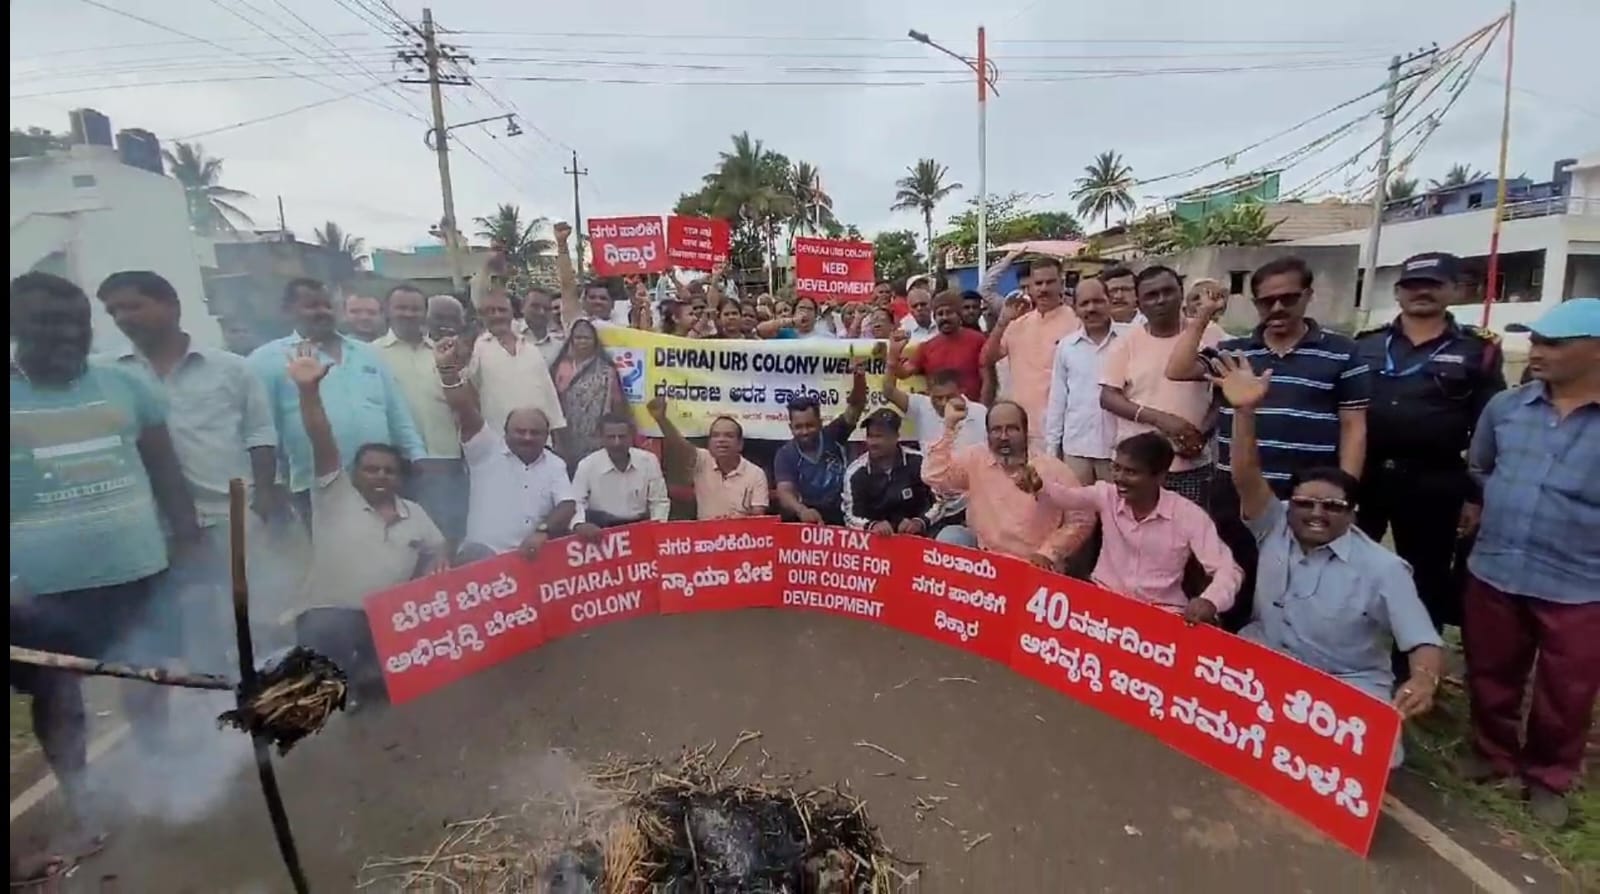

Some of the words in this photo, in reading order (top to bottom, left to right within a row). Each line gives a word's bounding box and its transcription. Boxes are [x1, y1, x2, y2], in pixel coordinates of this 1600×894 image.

[590, 223, 618, 239] ನಗರ
[822, 261, 849, 275] NEED
[829, 247, 845, 257] URS
[845, 248, 872, 259] COLONY
[797, 278, 875, 294] DEVELOPMENT
[654, 346, 715, 371] DEVRAJ
[719, 350, 748, 371] URS
[752, 353, 820, 375] COLONY
[566, 530, 633, 567] SAVE
[658, 537, 691, 556] ನಗರ
[801, 526, 835, 547] OUR
[838, 529, 872, 551] TAX
[778, 548, 829, 567] MONEY
[832, 551, 860, 571] USE
[862, 556, 891, 576] FOR
[923, 547, 997, 579] ಮಲತಾಯಿ
[455, 572, 518, 610] ಬೇಕು
[539, 566, 624, 604] DEVARAJ
[788, 568, 818, 586] OUR
[820, 571, 877, 594] COLONY
[912, 574, 946, 597] ನಗರ
[948, 586, 1007, 615] ಪಾಲಿಕೆಗೆ
[571, 590, 642, 622] COLONY
[783, 590, 885, 618] DEVELOPMENT
[485, 603, 538, 637] ಬೇಕು
[934, 609, 980, 642] ಧಿಕ್ಕಾರ
[1194, 655, 1275, 723] ನಮ್ಮ
[1282, 689, 1367, 755] ತೆರಿಗೆ
[1170, 696, 1266, 759] ನಮಗೆ
[1272, 745, 1369, 818] ಬಳಸಿ
